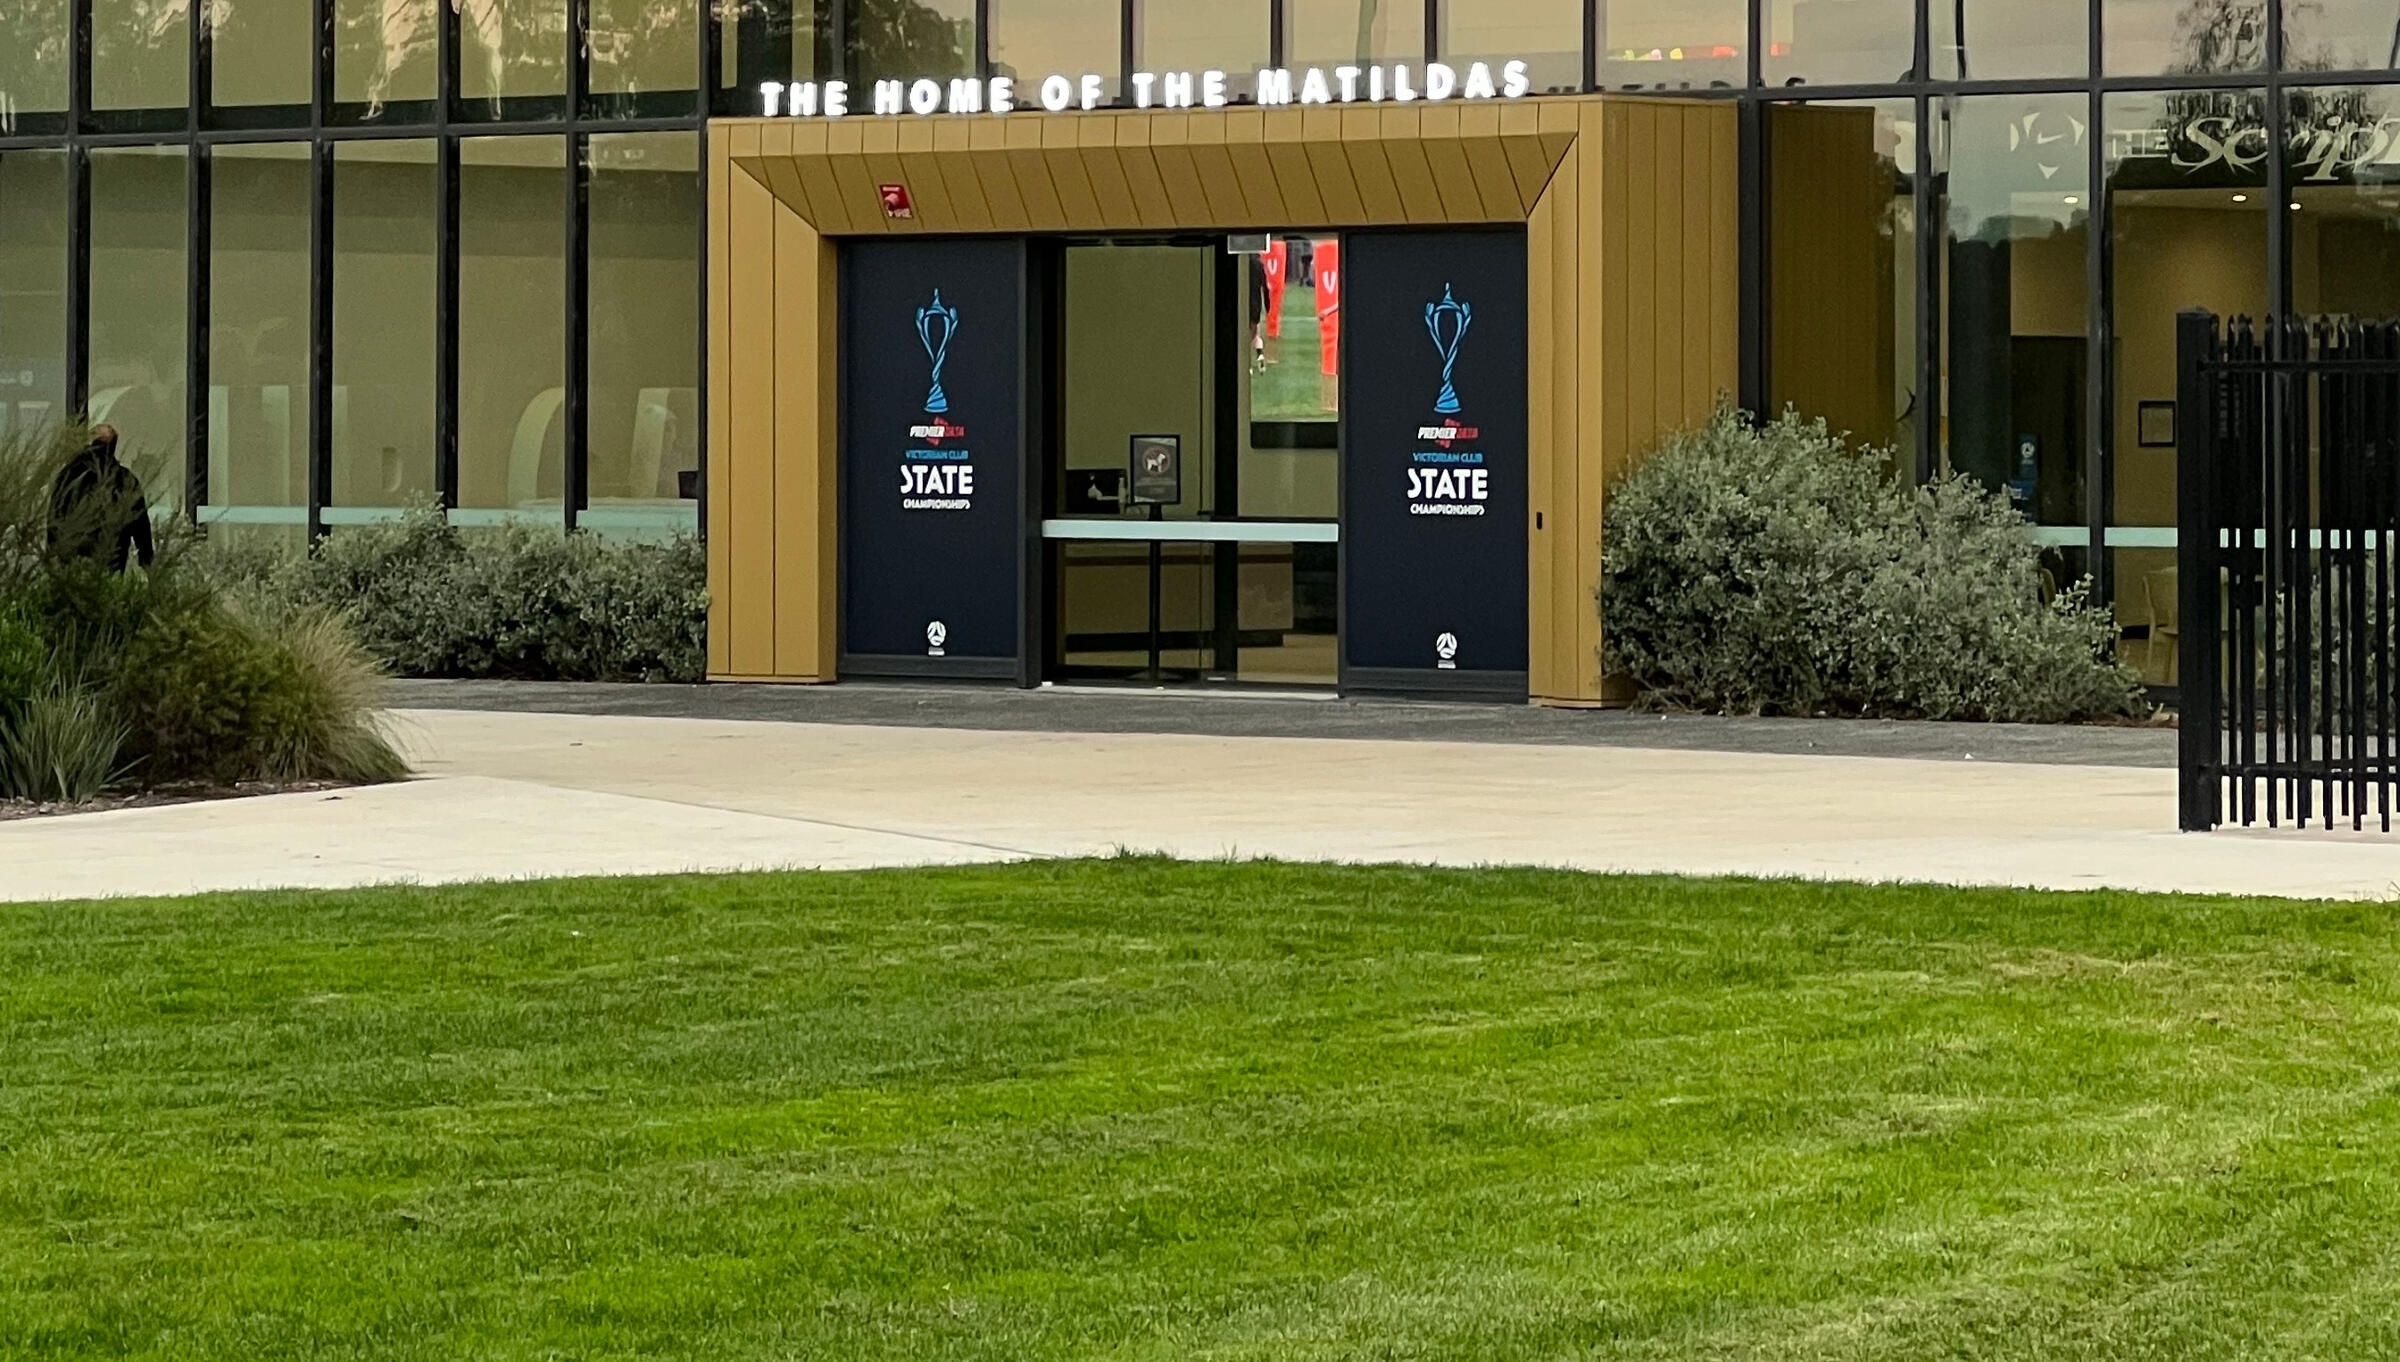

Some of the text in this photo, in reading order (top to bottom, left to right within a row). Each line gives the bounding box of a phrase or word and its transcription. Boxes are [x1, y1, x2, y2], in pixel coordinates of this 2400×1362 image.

[759, 59, 1530, 117] THE HOME OF THE MATILDAS
[1412, 452, 1483, 463] VICTORIAN CLUB
[900, 464, 974, 495] STATE
[1406, 467, 1489, 500] STATE
[903, 498, 971, 510] CHAMPIONSHIPS
[1409, 503, 1485, 516] CHAMPIONSHIPS
